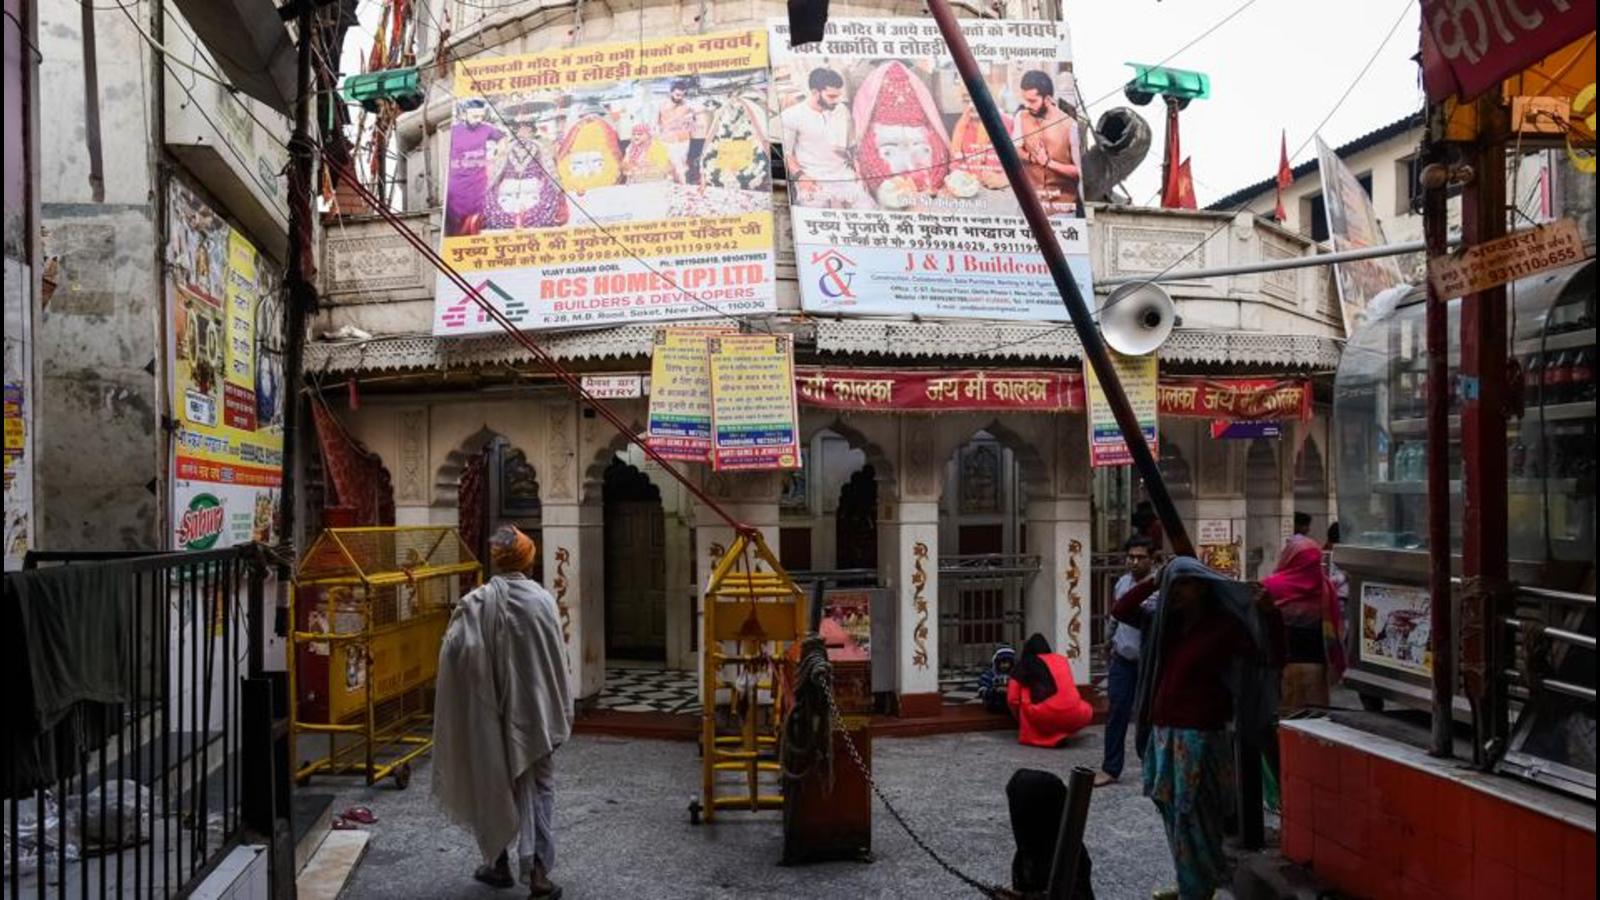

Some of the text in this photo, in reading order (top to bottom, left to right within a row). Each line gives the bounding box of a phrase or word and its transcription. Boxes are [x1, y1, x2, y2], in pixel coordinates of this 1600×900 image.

[452, 245, 489, 262] मुख्य
[495, 237, 540, 258] पुजारी
[548, 236, 567, 251] श्री
[740, 221, 761, 235] जी
[805, 219, 840, 234] मुख्य
[846, 218, 889, 236] पुजारी
[895, 221, 914, 234] श्री
[1060, 226, 1079, 241] जी
[905, 252, 916, 271] J
[923, 253, 938, 271] &
[946, 254, 956, 273] J
[540, 263, 769, 300] RCS HOMES (P) LTD.
[554, 287, 756, 311] BUILDERS & DEVELOPERS
[832, 379, 896, 405] कालका
[925, 378, 959, 401] जय
[962, 371, 988, 400] माँ
[991, 378, 1052, 404] कालका
